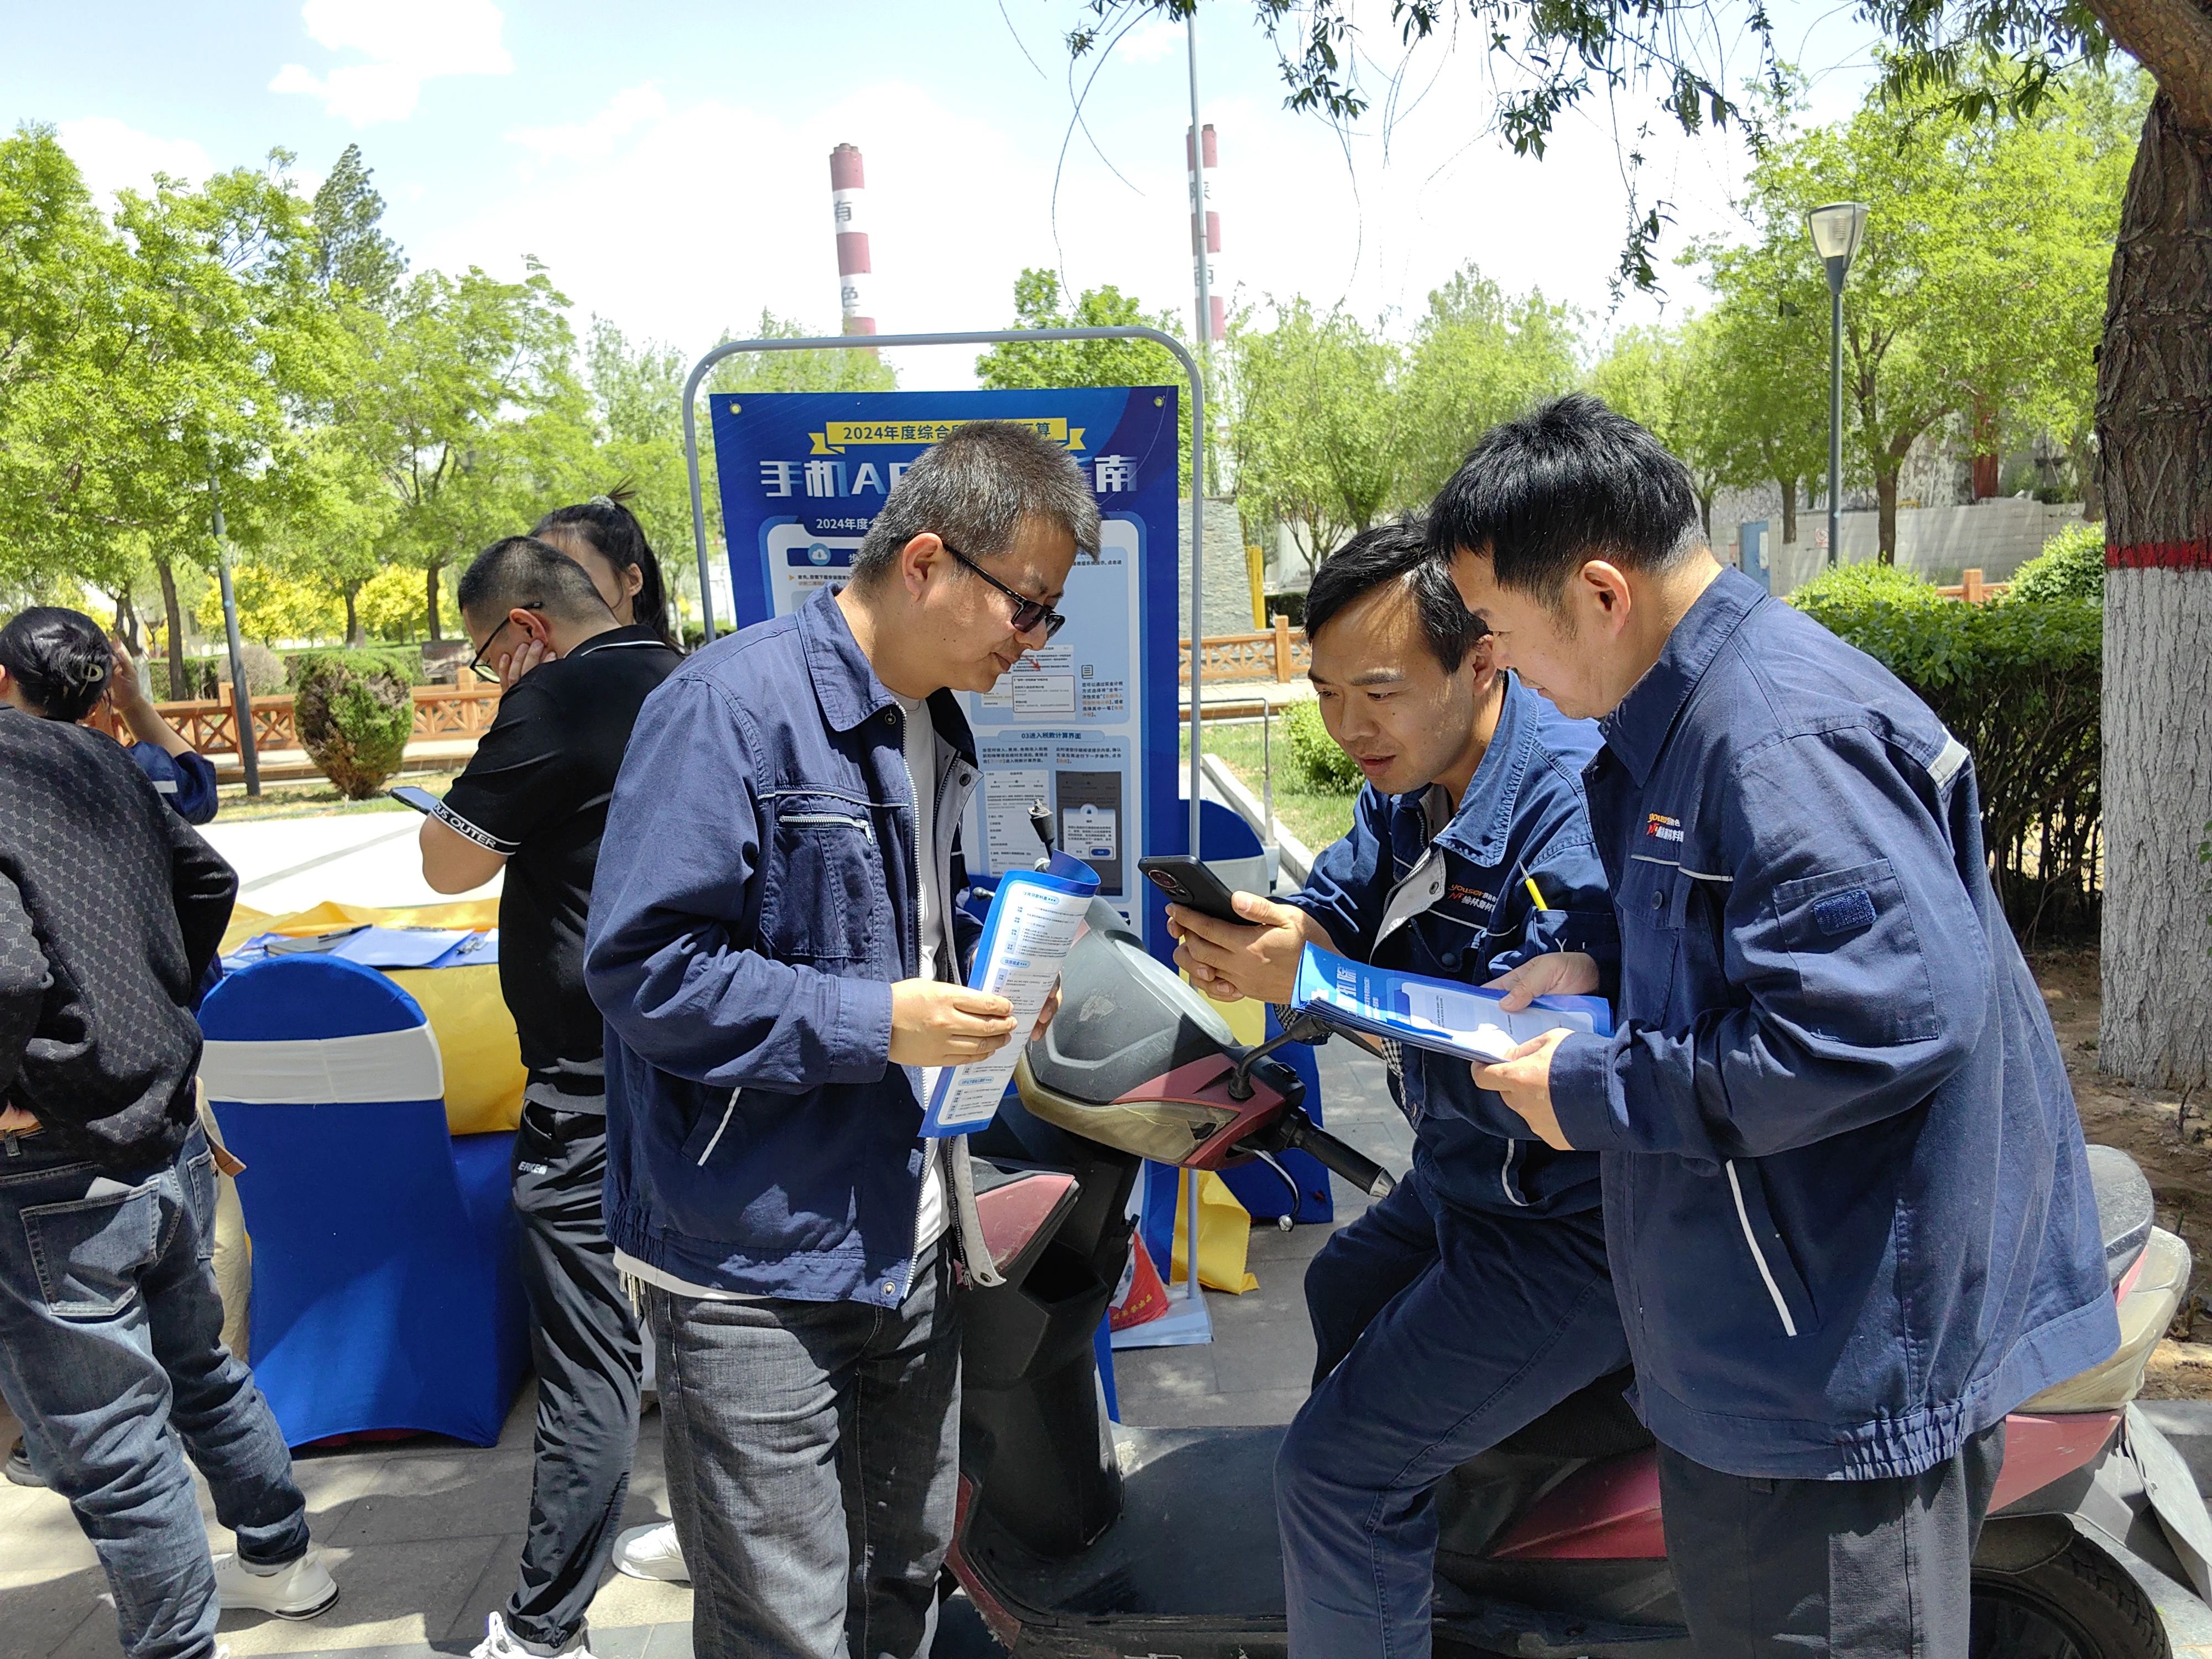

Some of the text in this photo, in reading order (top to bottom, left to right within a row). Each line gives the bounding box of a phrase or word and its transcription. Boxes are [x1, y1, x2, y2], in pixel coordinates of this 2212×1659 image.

[843, 422, 1051, 440] 2024年度综合 算
[1076, 454, 1138, 493] 南
[450, 817, 497, 848] OUTER
